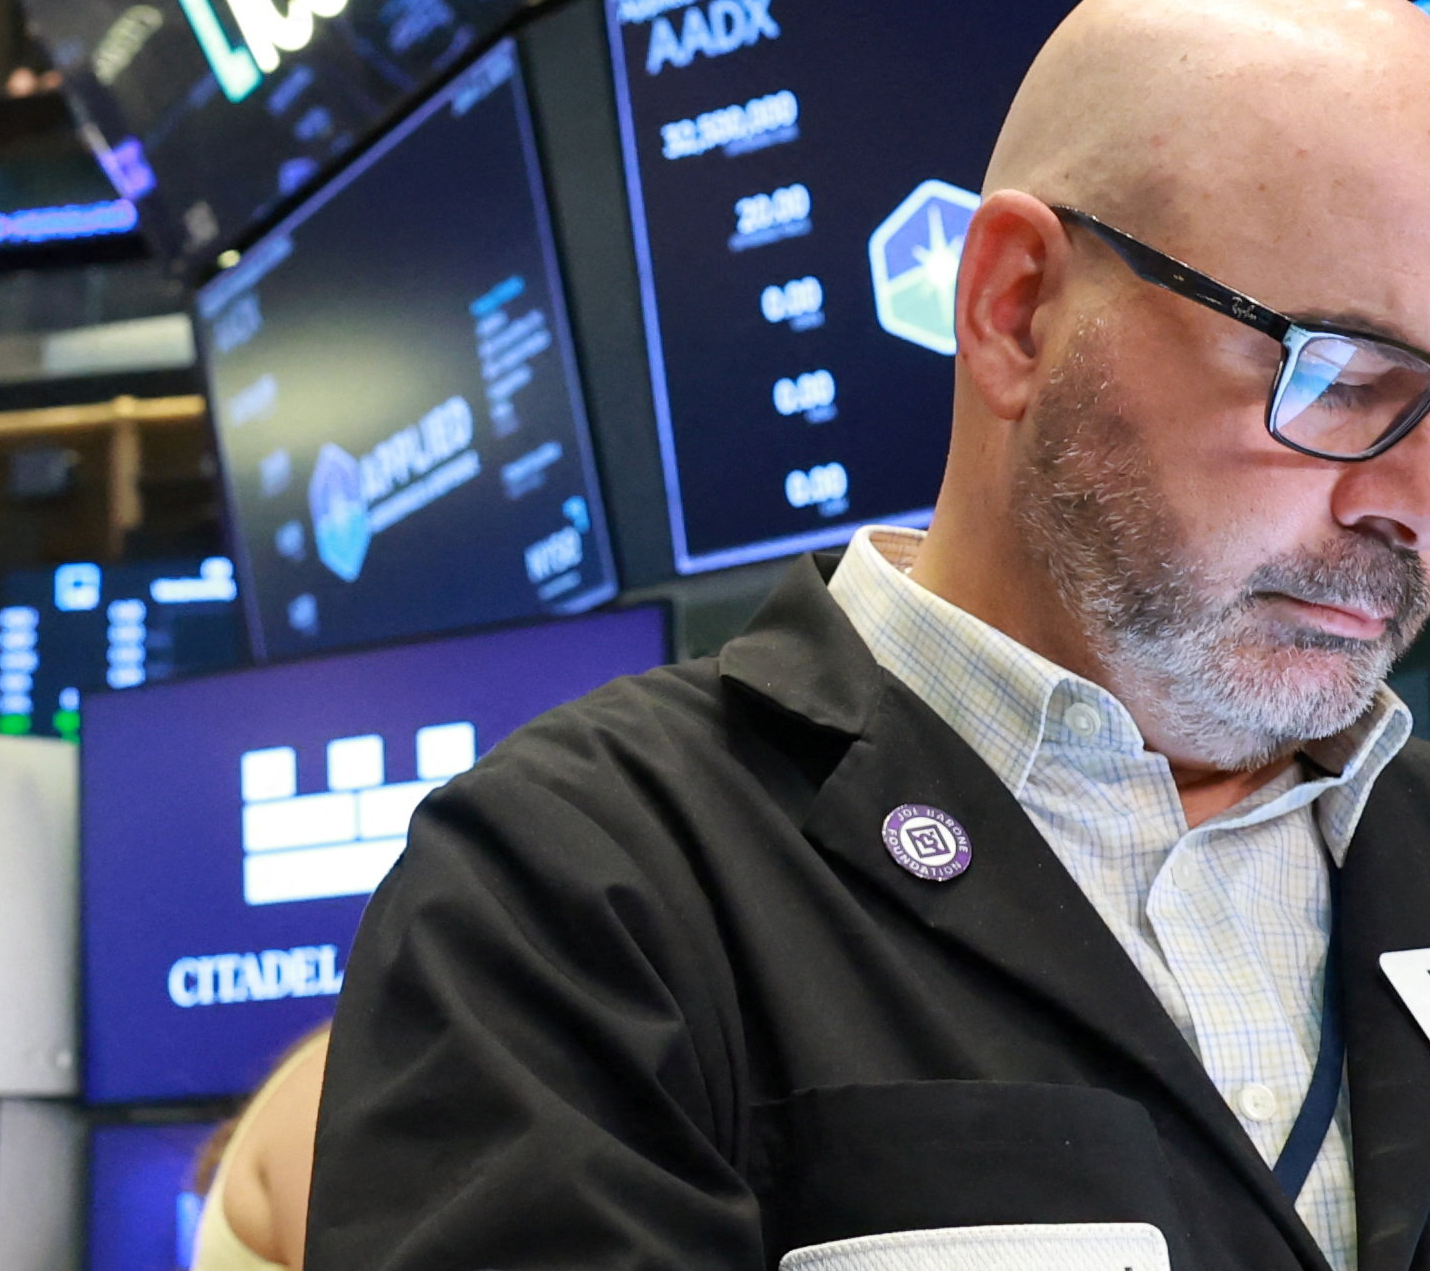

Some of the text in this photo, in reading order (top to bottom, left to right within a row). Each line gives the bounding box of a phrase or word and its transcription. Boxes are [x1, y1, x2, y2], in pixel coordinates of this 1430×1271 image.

[359, 396, 473, 502] APPLIED
[887, 829, 962, 877] FOUNDATION
[168, 943, 344, 1008] CITADEL
